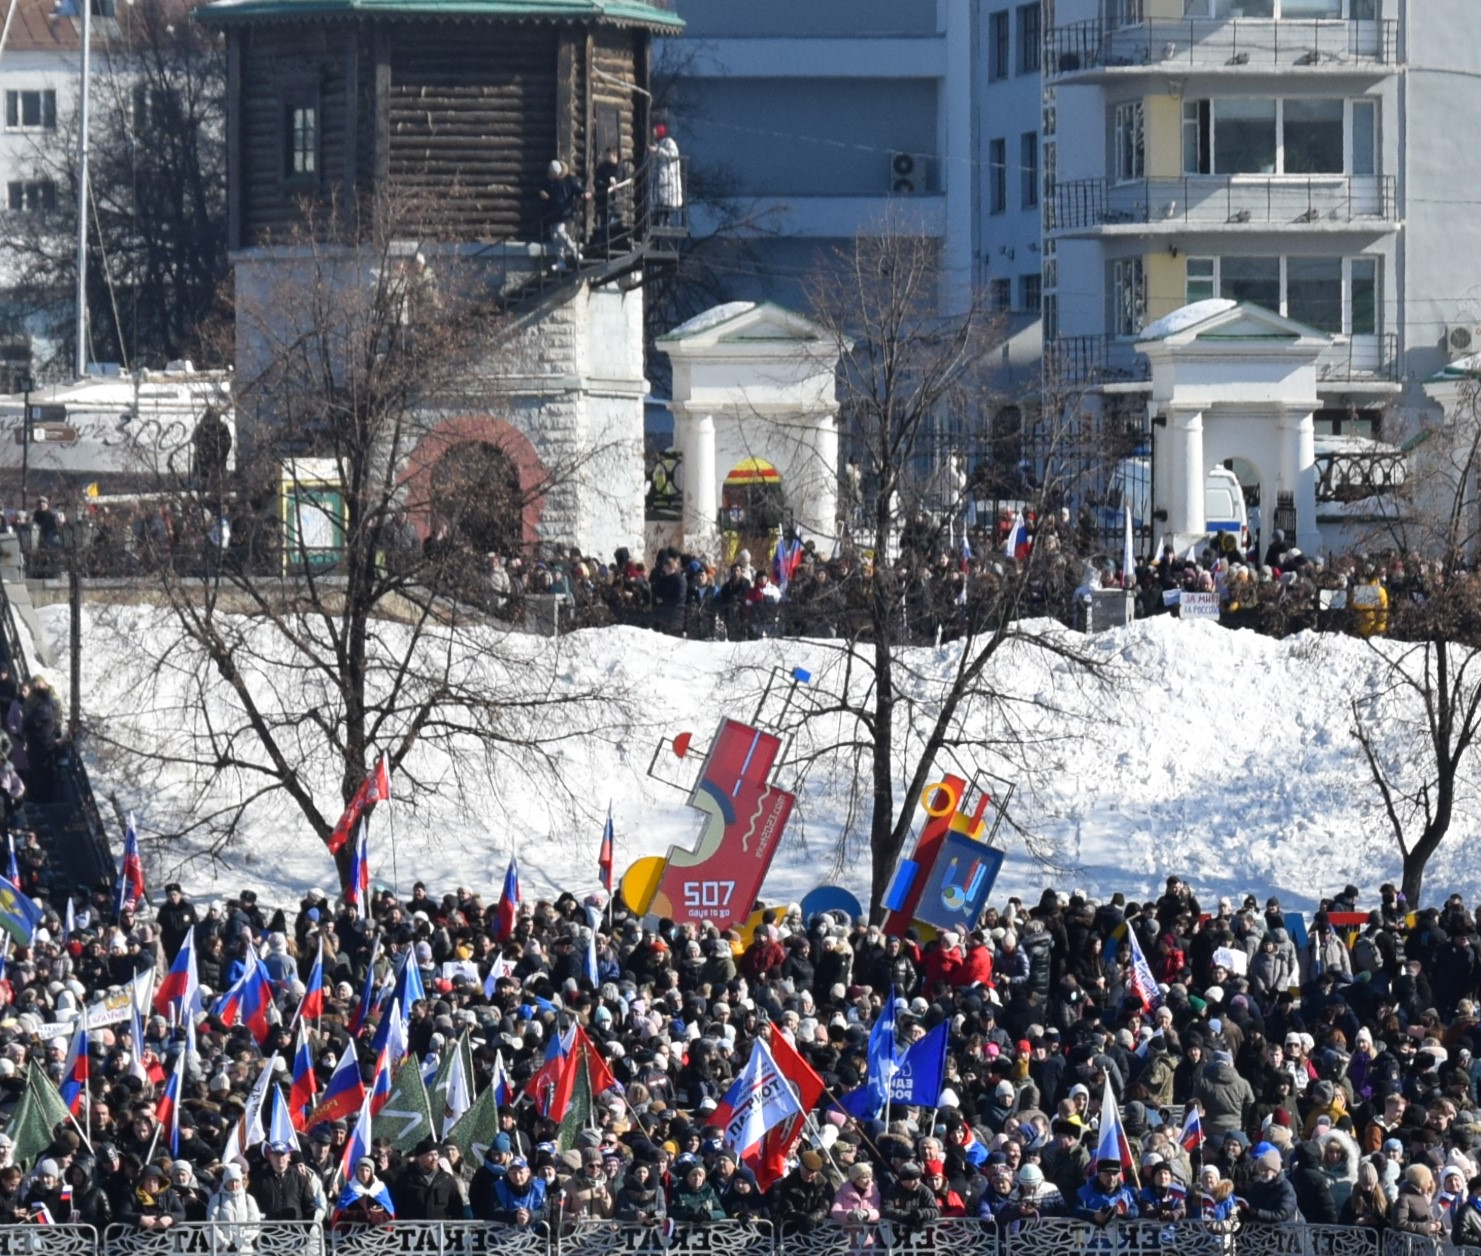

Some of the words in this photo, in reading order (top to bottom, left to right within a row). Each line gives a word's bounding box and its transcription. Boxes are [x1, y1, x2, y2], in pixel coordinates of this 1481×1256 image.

[684, 881, 735, 906] 507
[688, 908, 708, 918] days
[710, 909, 718, 917] to
[719, 909, 730, 918] go
